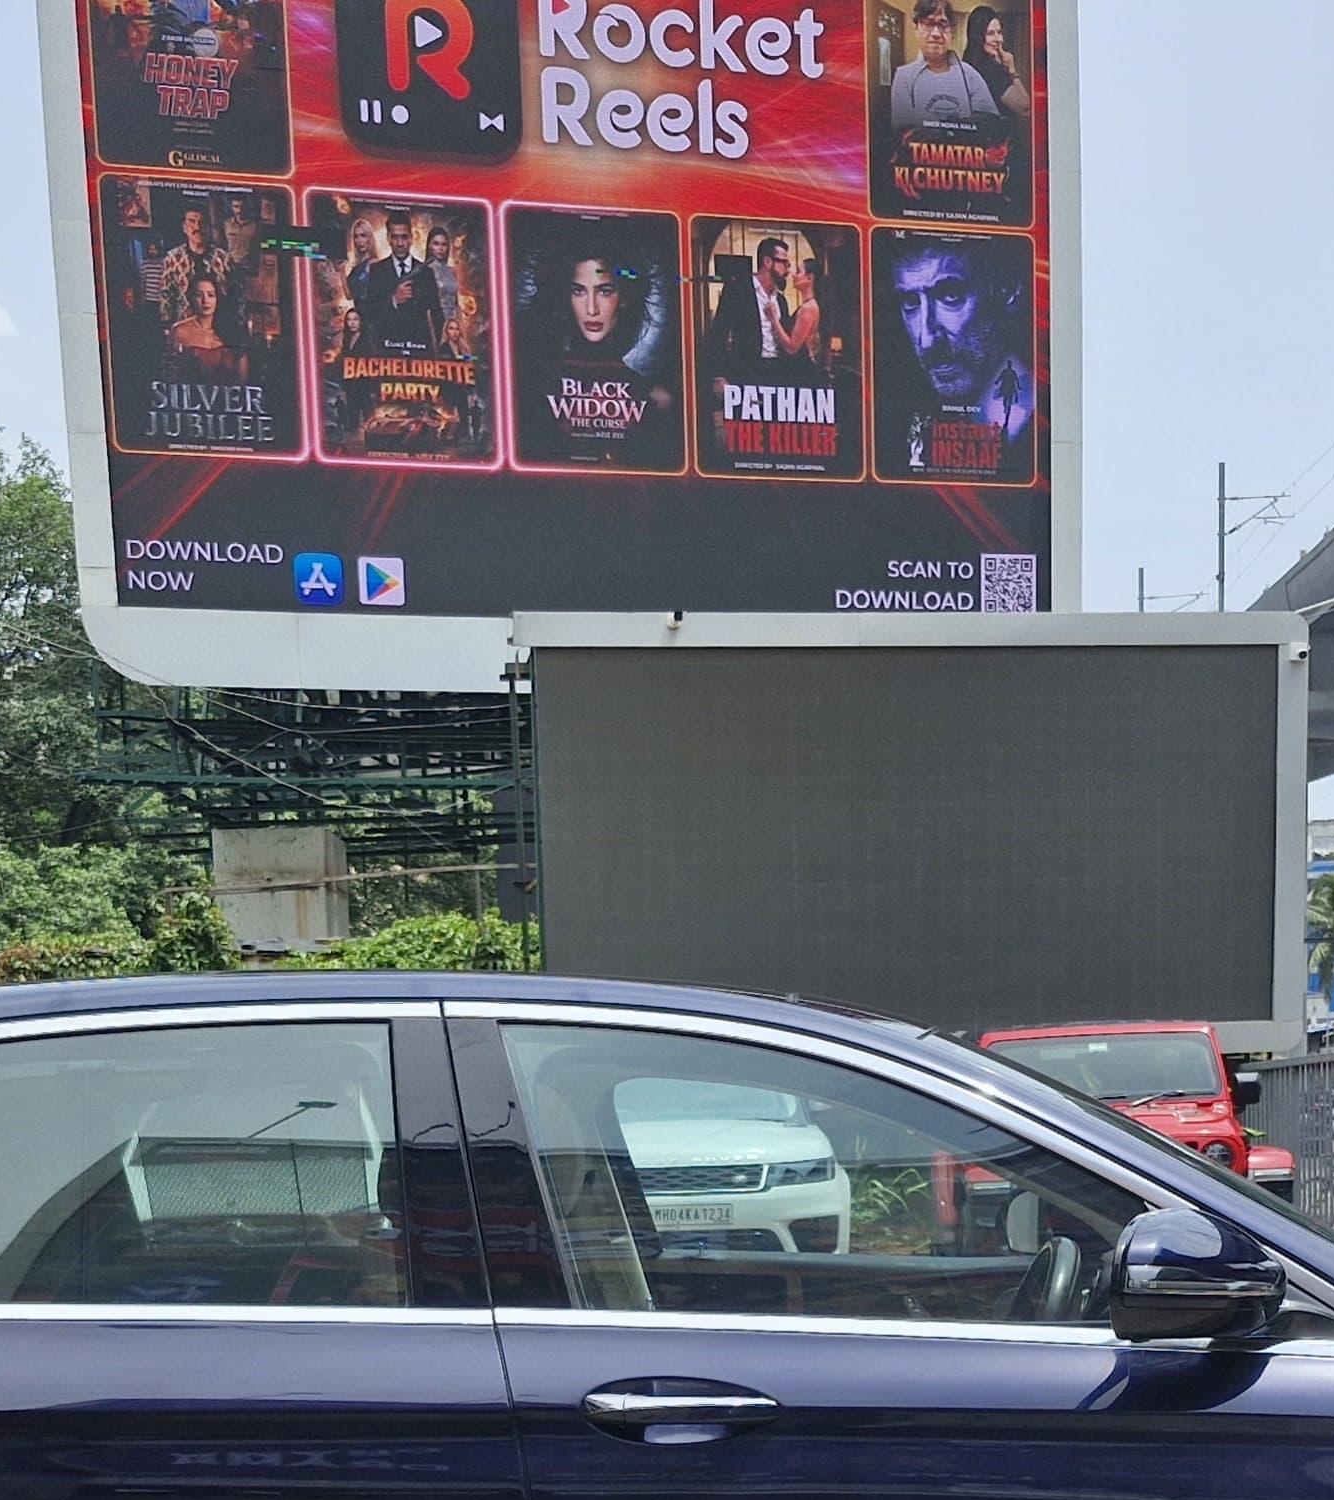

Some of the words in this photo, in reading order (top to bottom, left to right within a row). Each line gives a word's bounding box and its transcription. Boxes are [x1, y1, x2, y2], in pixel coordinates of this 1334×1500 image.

[538, 0, 824, 78] Rocket
[144, 52, 239, 88] HONEY
[157, 85, 230, 119] TRAP
[540, 66, 750, 159] Reels
[909, 142, 986, 168] TAMATAR
[913, 166, 1006, 194] CHUTNEY
[343, 357, 476, 385] BACHELORETTE
[151, 381, 268, 414] SILVER
[380, 382, 441, 402] PARTY
[561, 378, 632, 399] BLACK
[546, 395, 647, 423] WIDOW
[723, 384, 835, 424] PATHAN
[146, 411, 275, 441] JUBILEE
[571, 417, 591, 427] THE
[593, 417, 627, 429] CURSE
[725, 421, 764, 453] THE
[769, 423, 837, 456] KILLER
[125, 539, 284, 565] DOWNLOAD
[128, 570, 194, 592] NOW
[887, 560, 941, 579] SCAN
[947, 561, 974, 579] TO
[835, 589, 974, 611] DOWNLOAD
